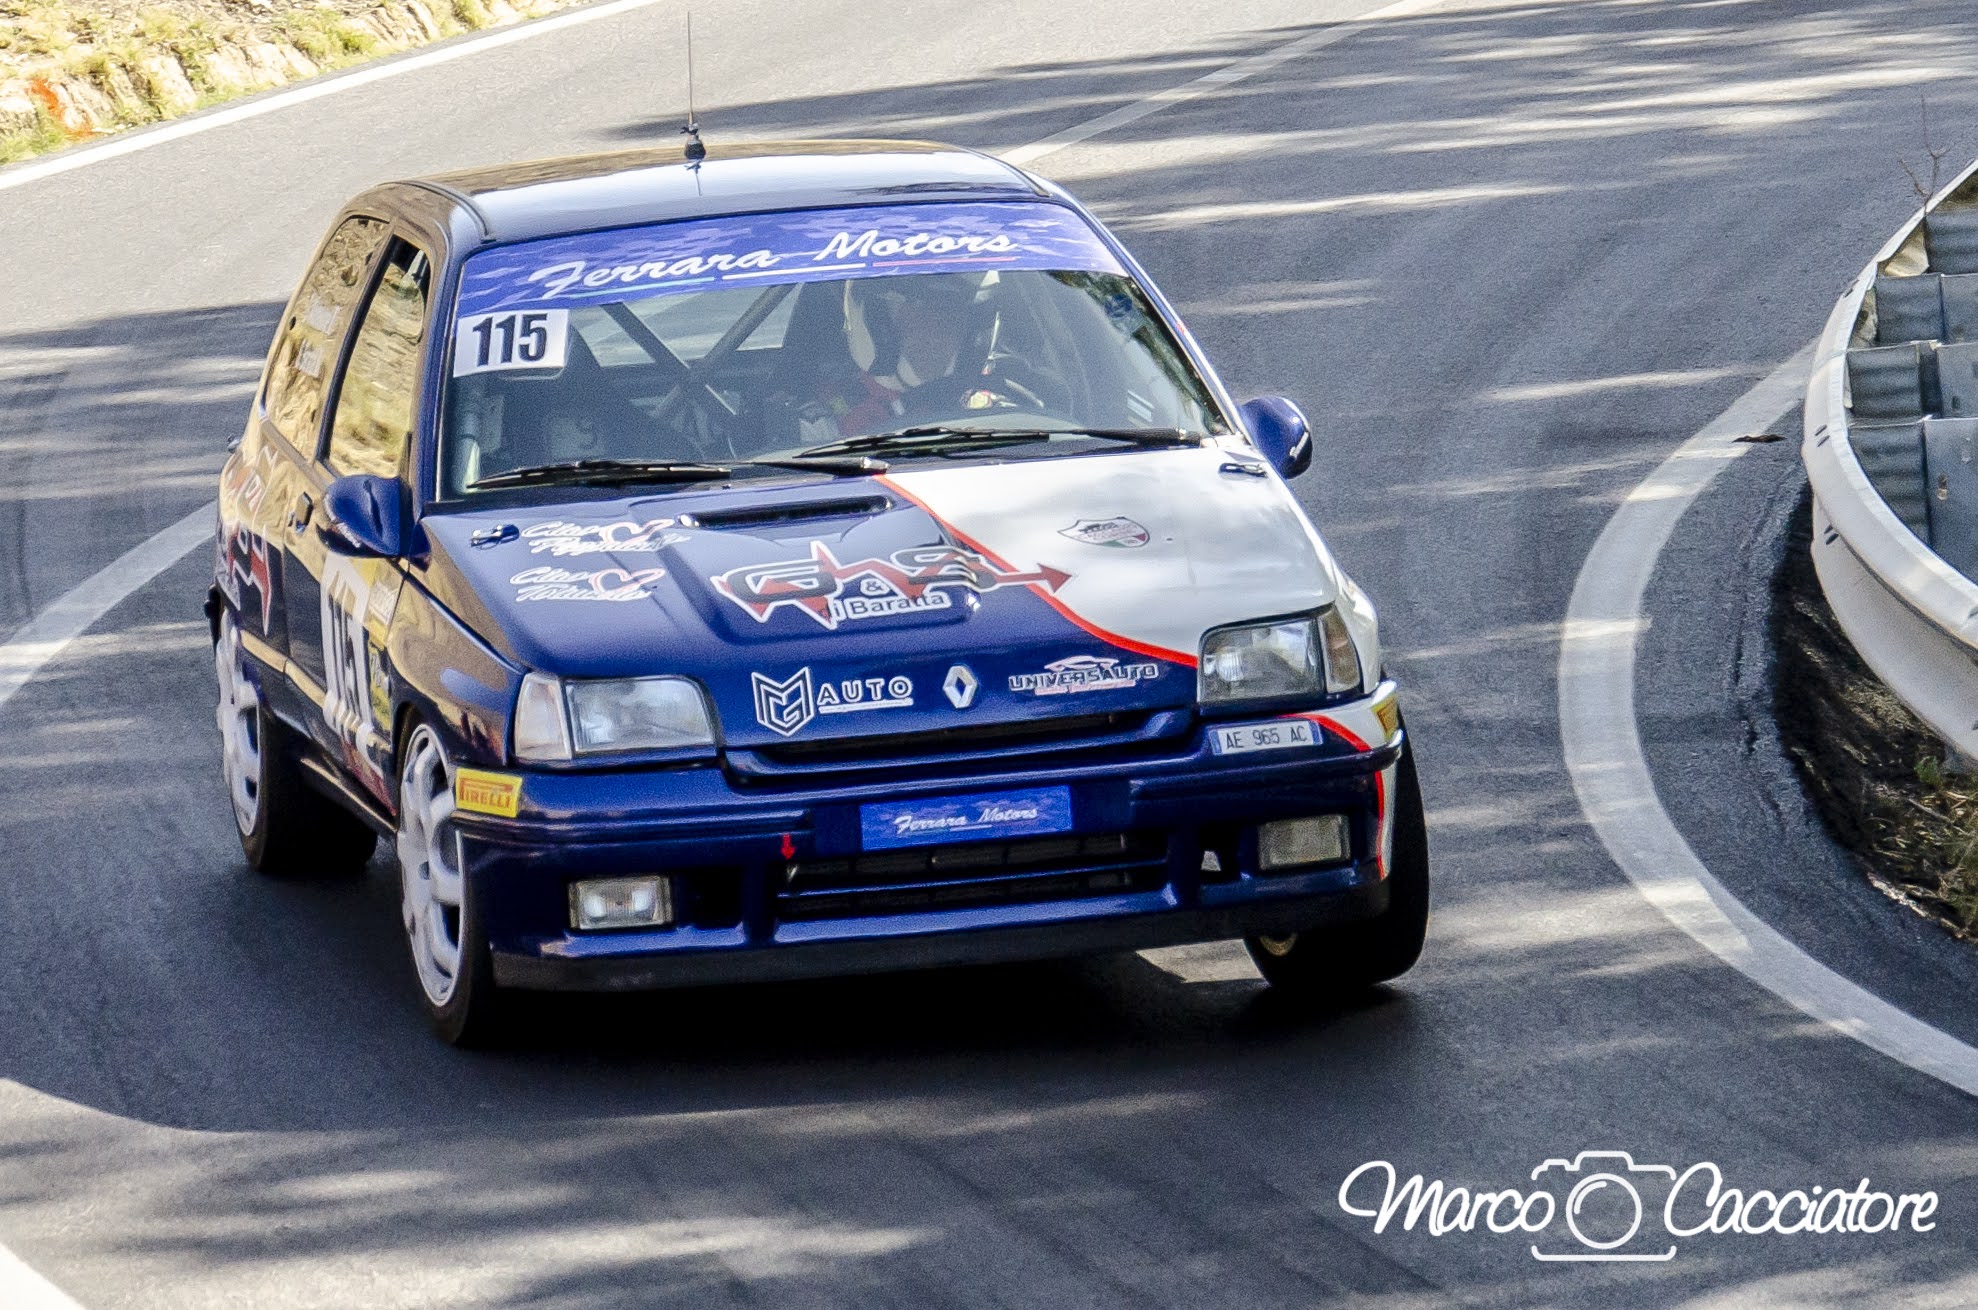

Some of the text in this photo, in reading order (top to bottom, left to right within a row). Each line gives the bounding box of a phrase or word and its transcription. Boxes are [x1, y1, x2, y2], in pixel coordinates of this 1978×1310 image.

[527, 230, 1019, 299] Ferrara Motors
[472, 312, 548, 368] 115
[848, 594, 946, 615] Baratta
[817, 675, 913, 705] AUTO
[1008, 663, 1160, 692] UNIVERSAUTO
[1226, 725, 1308, 749] AE 965 AC
[458, 777, 514, 809] PIRELLI
[893, 807, 1038, 834] Ferrara Motors
